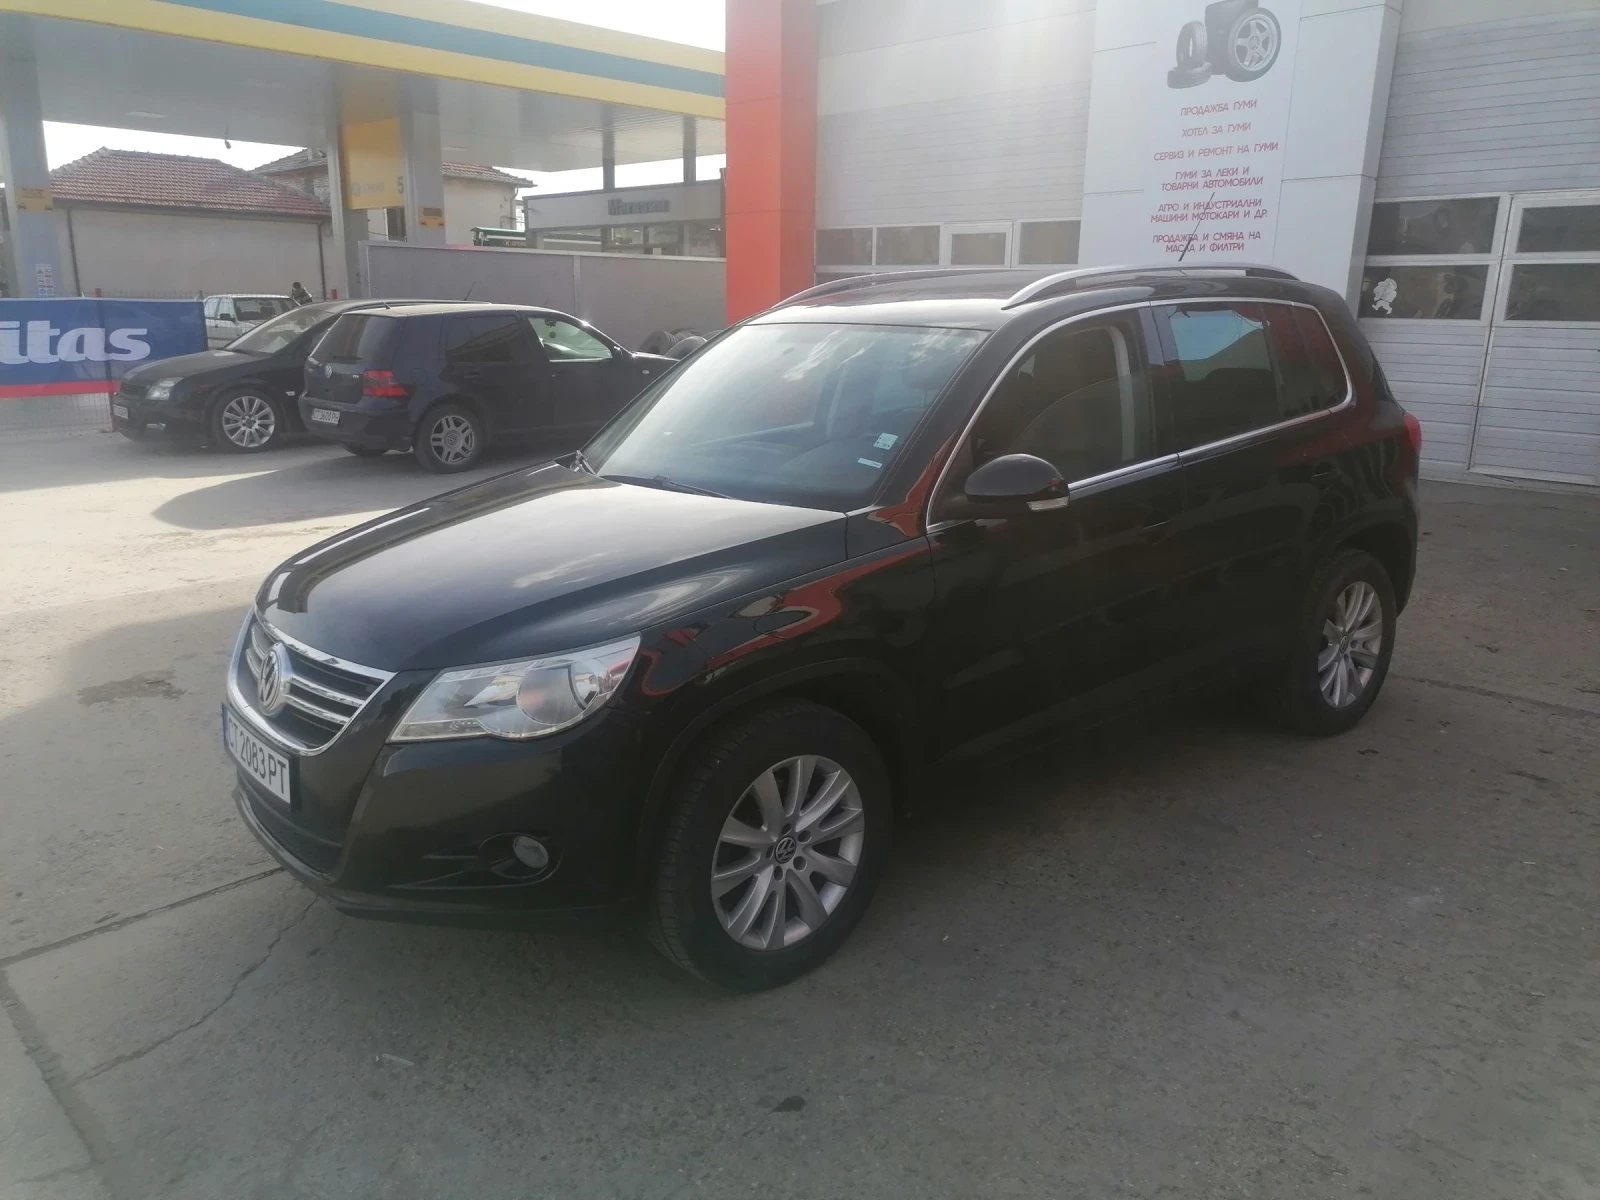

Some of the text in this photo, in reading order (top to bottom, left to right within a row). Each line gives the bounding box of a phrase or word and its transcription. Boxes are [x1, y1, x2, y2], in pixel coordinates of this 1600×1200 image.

[1181, 100, 1257, 116] ПРОДАЖБА ГУМИ
[1182, 123, 1251, 138] ХОТЕЛ ЗА ГУМИ
[1154, 142, 1278, 161] СЕРВИЗ И РЕМОНТ НА ГУМИ
[1175, 166, 1249, 180] ГУМИ ЗА ЛЕКИ И
[397, 175, 404, 194] 5
[1161, 177, 1263, 191] ТОВАРНИ АВТОМОБИЛИ
[1158, 199, 1262, 212] АГРО И ИНДУСТРИАЛНИ
[1150, 213, 1188, 223] МАШИНИ
[1192, 211, 1239, 220] МОТОКАРИ
[1244, 210, 1250, 218] И
[1202, 233, 1209, 241] И
[1213, 232, 1244, 240] СМЯНА
[1249, 231, 1261, 239] НА
[1199, 243, 1206, 251] И
[1210, 243, 1244, 251] ФИЛТРИ
